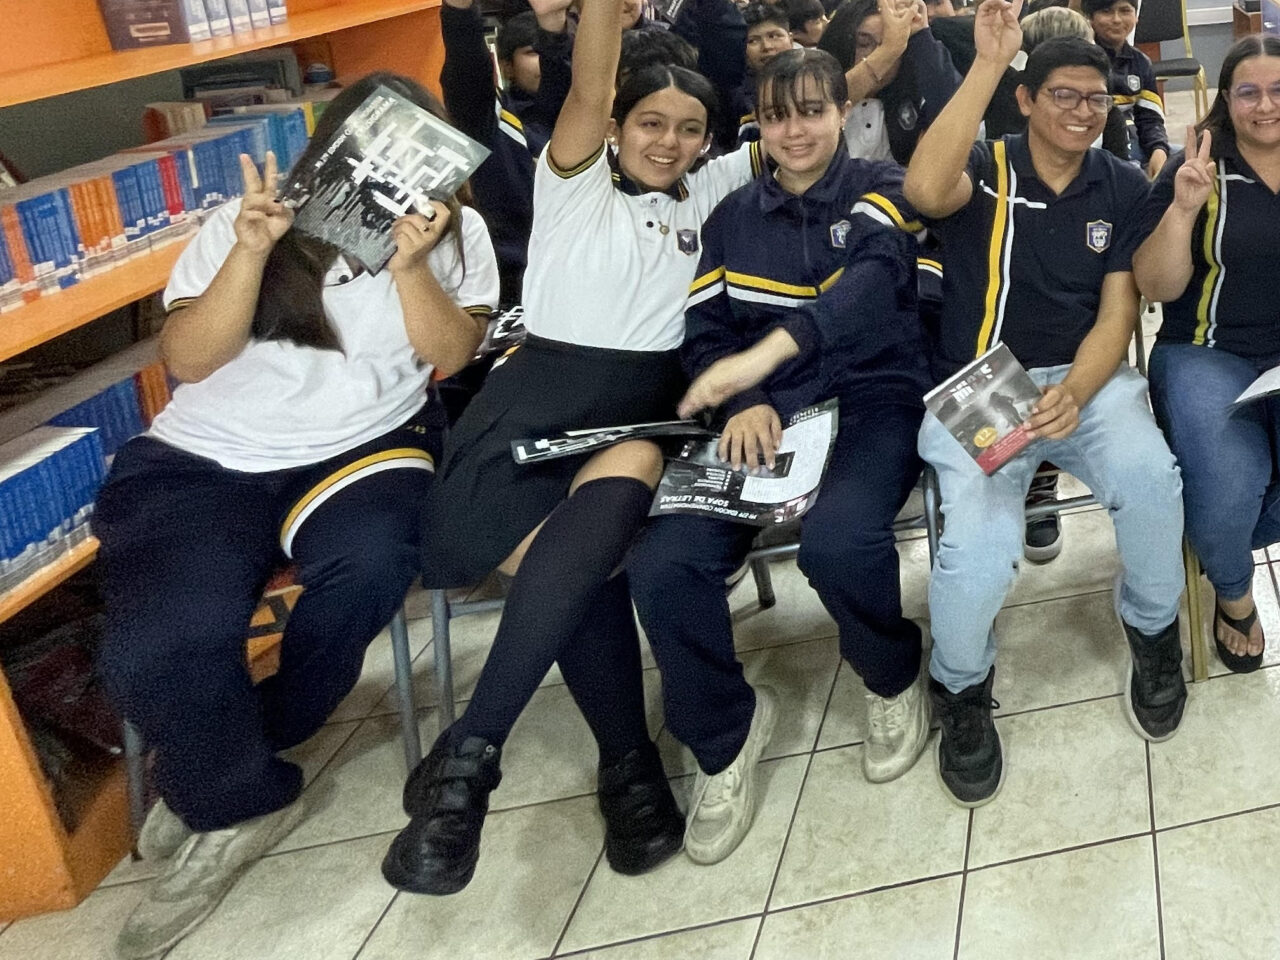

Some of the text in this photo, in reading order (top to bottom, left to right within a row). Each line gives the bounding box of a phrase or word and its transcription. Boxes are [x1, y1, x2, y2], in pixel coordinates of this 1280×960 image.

[660, 495, 729, 507] SOPA DE LETRAS
